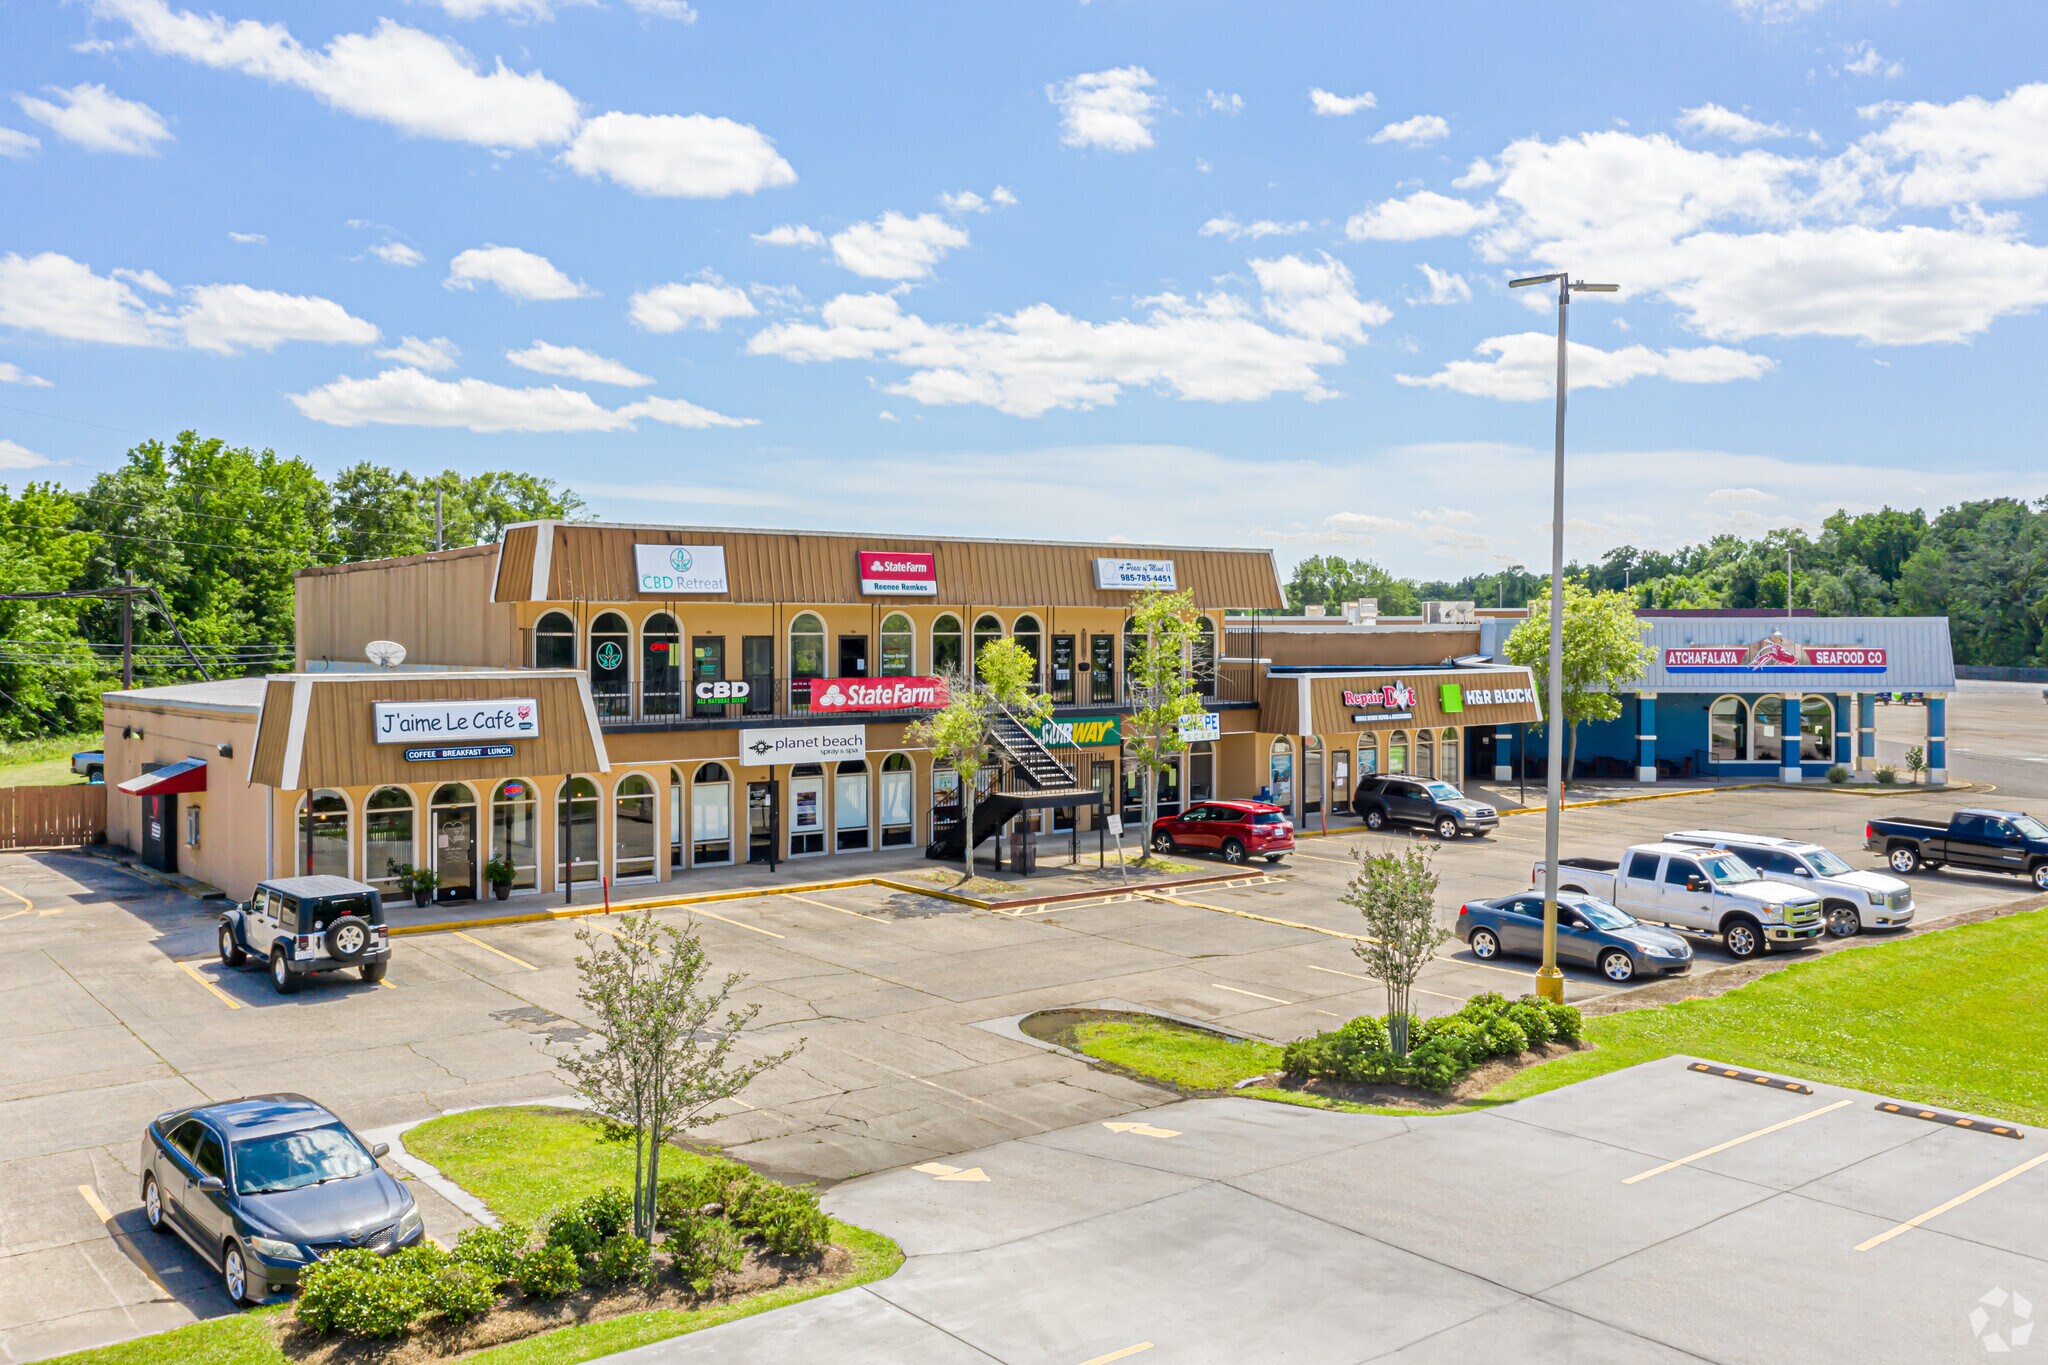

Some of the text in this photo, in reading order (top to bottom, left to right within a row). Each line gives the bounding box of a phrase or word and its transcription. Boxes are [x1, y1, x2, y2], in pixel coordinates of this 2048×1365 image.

[1119, 563, 1125, 571] A
[642, 575, 724, 590] CBD Retreat
[1120, 574, 1171, 582] 985-785-4451
[874, 582, 927, 591] Reenee Remkes
[1668, 651, 1883, 664] ATCHAFALAYA SEAFOOD CO
[695, 681, 750, 699] CBD
[1465, 688, 1534, 705] H&R BLOCK
[1344, 689, 1384, 707] Repair
[382, 710, 515, 733] J'aime Le Café
[1039, 720, 1115, 744] SUBWAY
[775, 734, 863, 752] planet beach
[408, 747, 511, 759] COFFEE BREAKFAST LUNCH
[820, 748, 839, 756] spray
